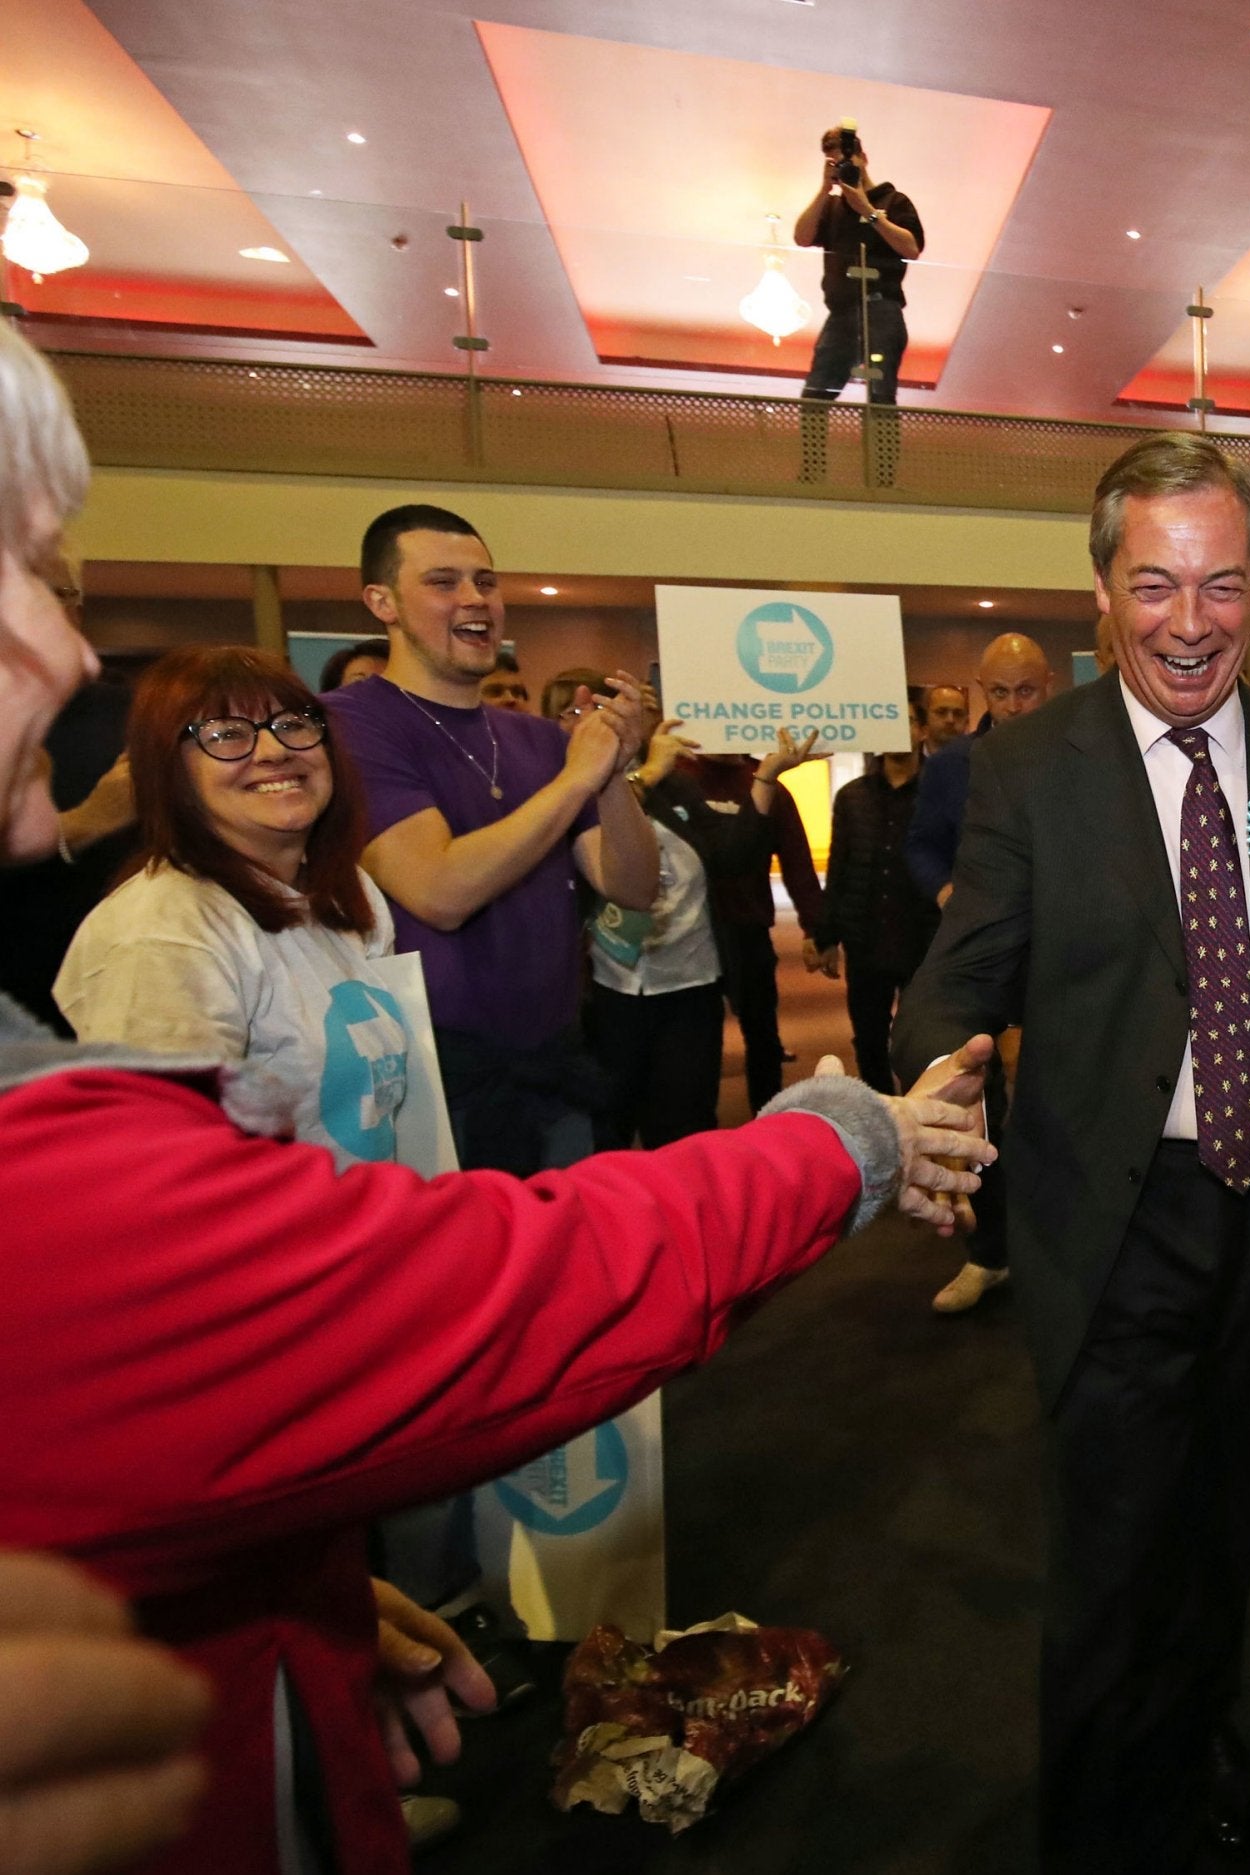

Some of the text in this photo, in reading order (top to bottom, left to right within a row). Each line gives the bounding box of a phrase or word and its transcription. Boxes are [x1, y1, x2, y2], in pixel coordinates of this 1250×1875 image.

[766, 640, 815, 655] BREXIT
[675, 702, 899, 720] CHANGE POLITICS
[725, 725, 775, 741] FOR
